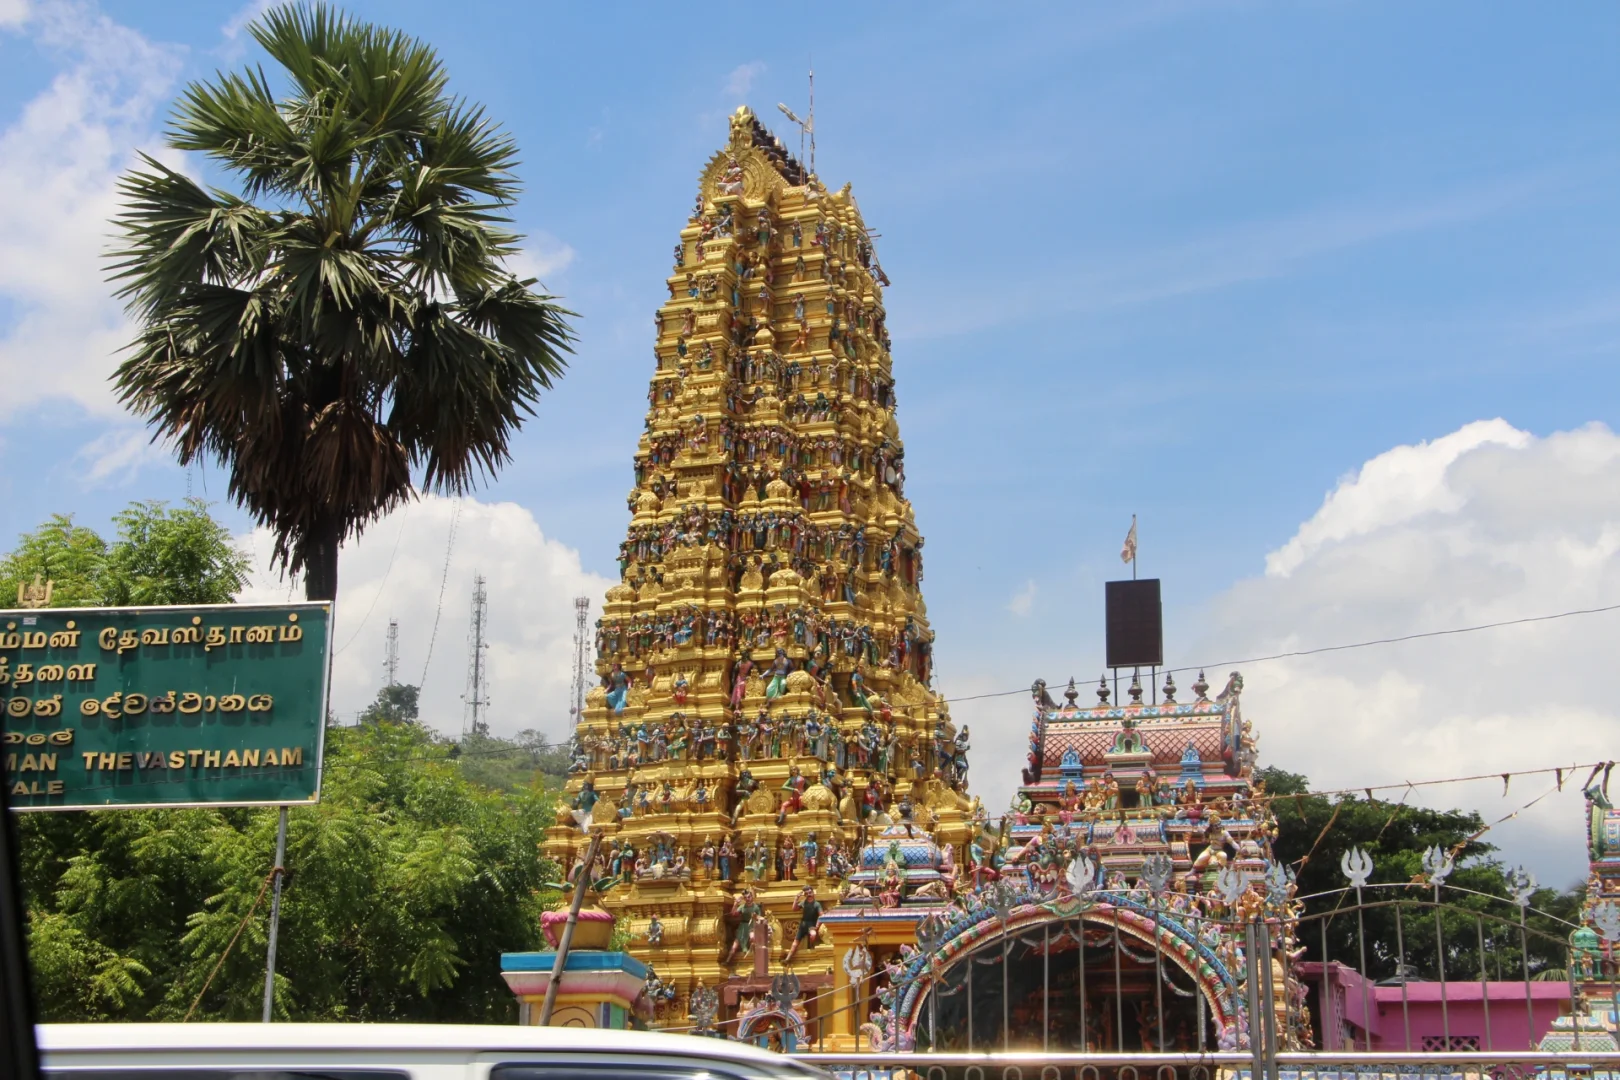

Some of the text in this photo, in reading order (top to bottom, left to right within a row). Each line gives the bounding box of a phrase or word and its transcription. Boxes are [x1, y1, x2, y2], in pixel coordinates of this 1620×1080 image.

[98, 612, 303, 655] தேவஸ்தானம்
[0, 690, 274, 719] මන් දේවස්ථානය
[82, 746, 303, 771] THEVASTHANAM
